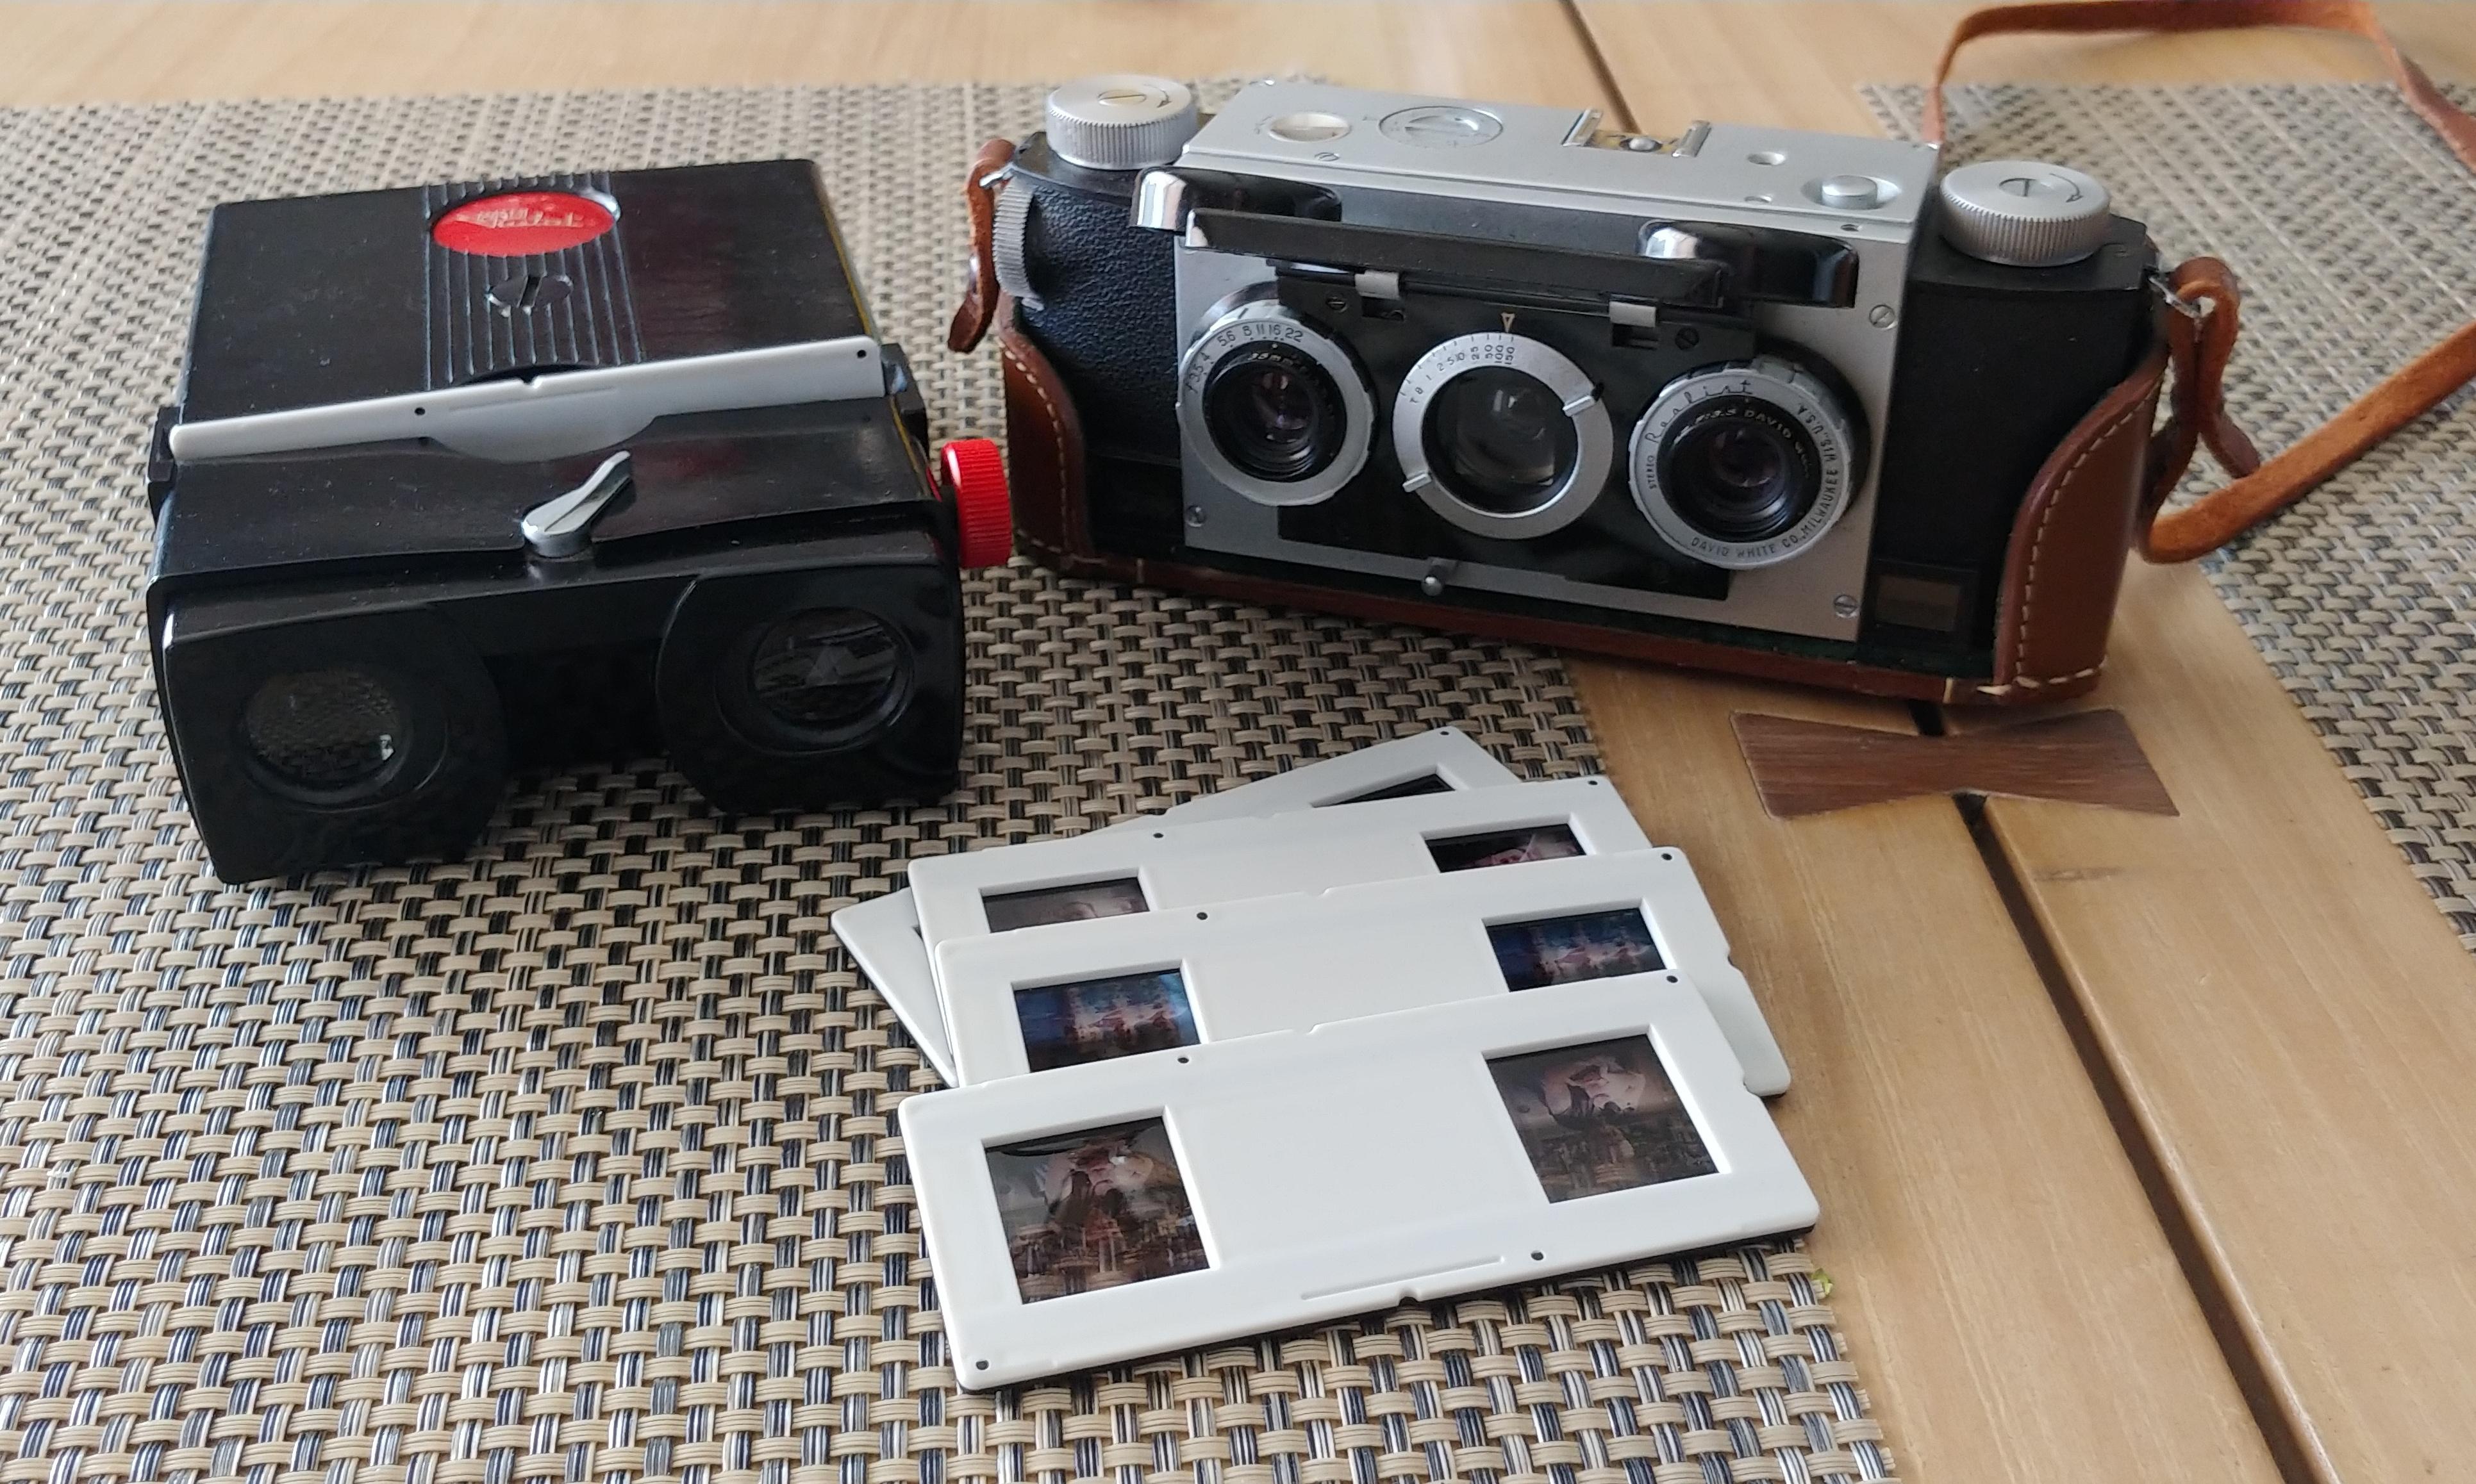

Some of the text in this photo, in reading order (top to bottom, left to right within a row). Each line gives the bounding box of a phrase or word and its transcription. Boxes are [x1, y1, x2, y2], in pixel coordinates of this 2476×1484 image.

[1201, 352, 1211, 361] 4
[1242, 325, 1252, 336] 8
[1255, 324, 1265, 335] 11
[1268, 324, 1281, 336] 16
[1284, 327, 1304, 343] 22
[1436, 362, 1445, 372] 2
[1446, 356, 1455, 366] 5
[1470, 346, 1481, 361] 25
[1484, 344, 1494, 359] 50
[1494, 345, 1504, 364] 100
[1504, 346, 1516, 366] 150
[1644, 379, 1754, 444] Realist
[1744, 409, 1792, 439] DAVID
[1645, 454, 1657, 490] STEREO
[1691, 537, 1731, 557] DAVID
[1736, 543, 1776, 559] WHITE
[1800, 469, 1838, 536] MILWAUKEE
